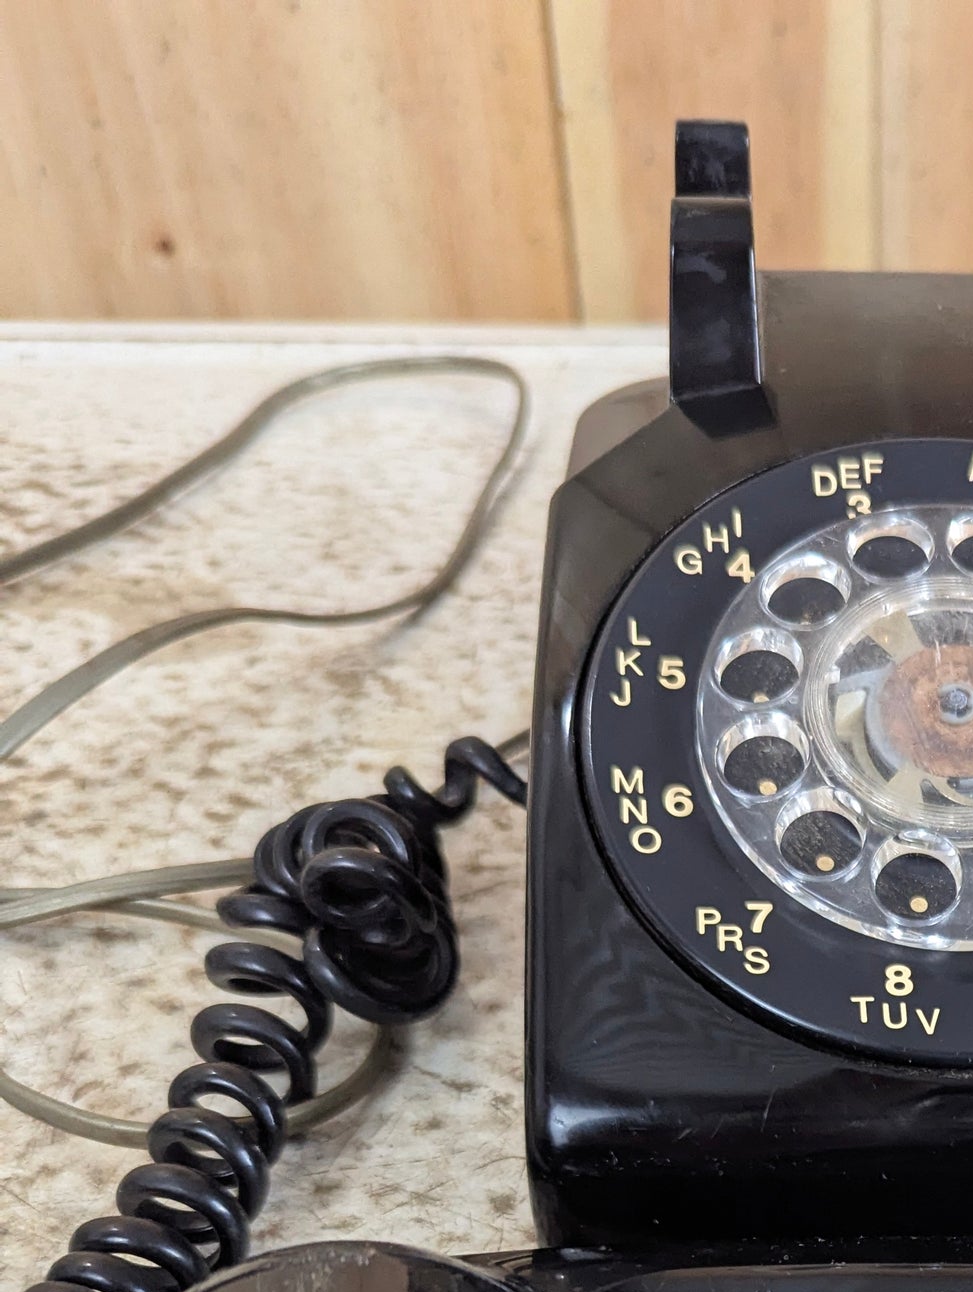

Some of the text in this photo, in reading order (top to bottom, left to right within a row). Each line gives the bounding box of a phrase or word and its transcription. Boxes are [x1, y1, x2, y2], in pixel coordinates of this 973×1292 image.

[812, 453, 884, 497] DEF
[848, 490, 873, 520] 3
[674, 506, 743, 576] GHI
[726, 549, 756, 584] 4
[657, 655, 687, 691] 5
[611, 765, 663, 855] MNO
[661, 783, 695, 818] 6
[744, 900, 774, 934] 7
[696, 906, 771, 975] PRS
[884, 964, 915, 997] 8
[849, 995, 941, 1036] TUV
